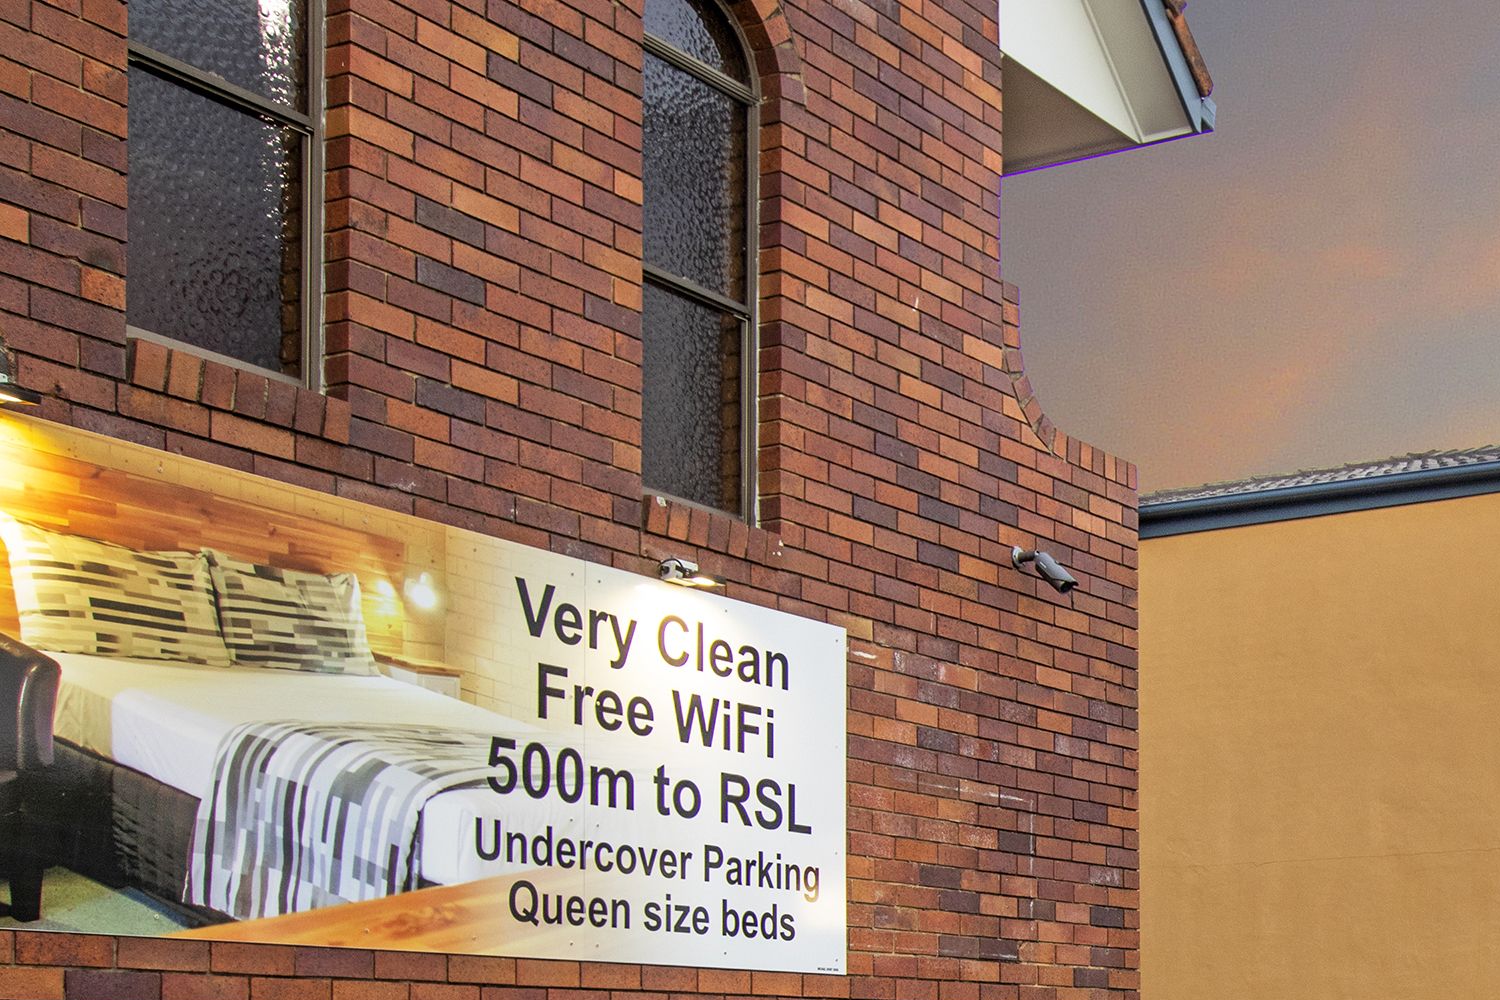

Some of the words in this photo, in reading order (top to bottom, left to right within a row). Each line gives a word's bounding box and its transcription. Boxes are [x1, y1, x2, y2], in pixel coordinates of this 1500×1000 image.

[515, 576, 637, 669] Very
[658, 614, 789, 691] Clean
[537, 662, 654, 736] Free
[672, 689, 775, 758] WiFi
[486, 736, 635, 811] 500m
[653, 764, 701, 819] to
[720, 772, 812, 835] RSL
[475, 817, 693, 880] Undercover
[703, 844, 820, 903] Parking
[509, 880, 631, 929] Queen
[643, 894, 710, 936] size
[722, 899, 796, 941] beds
